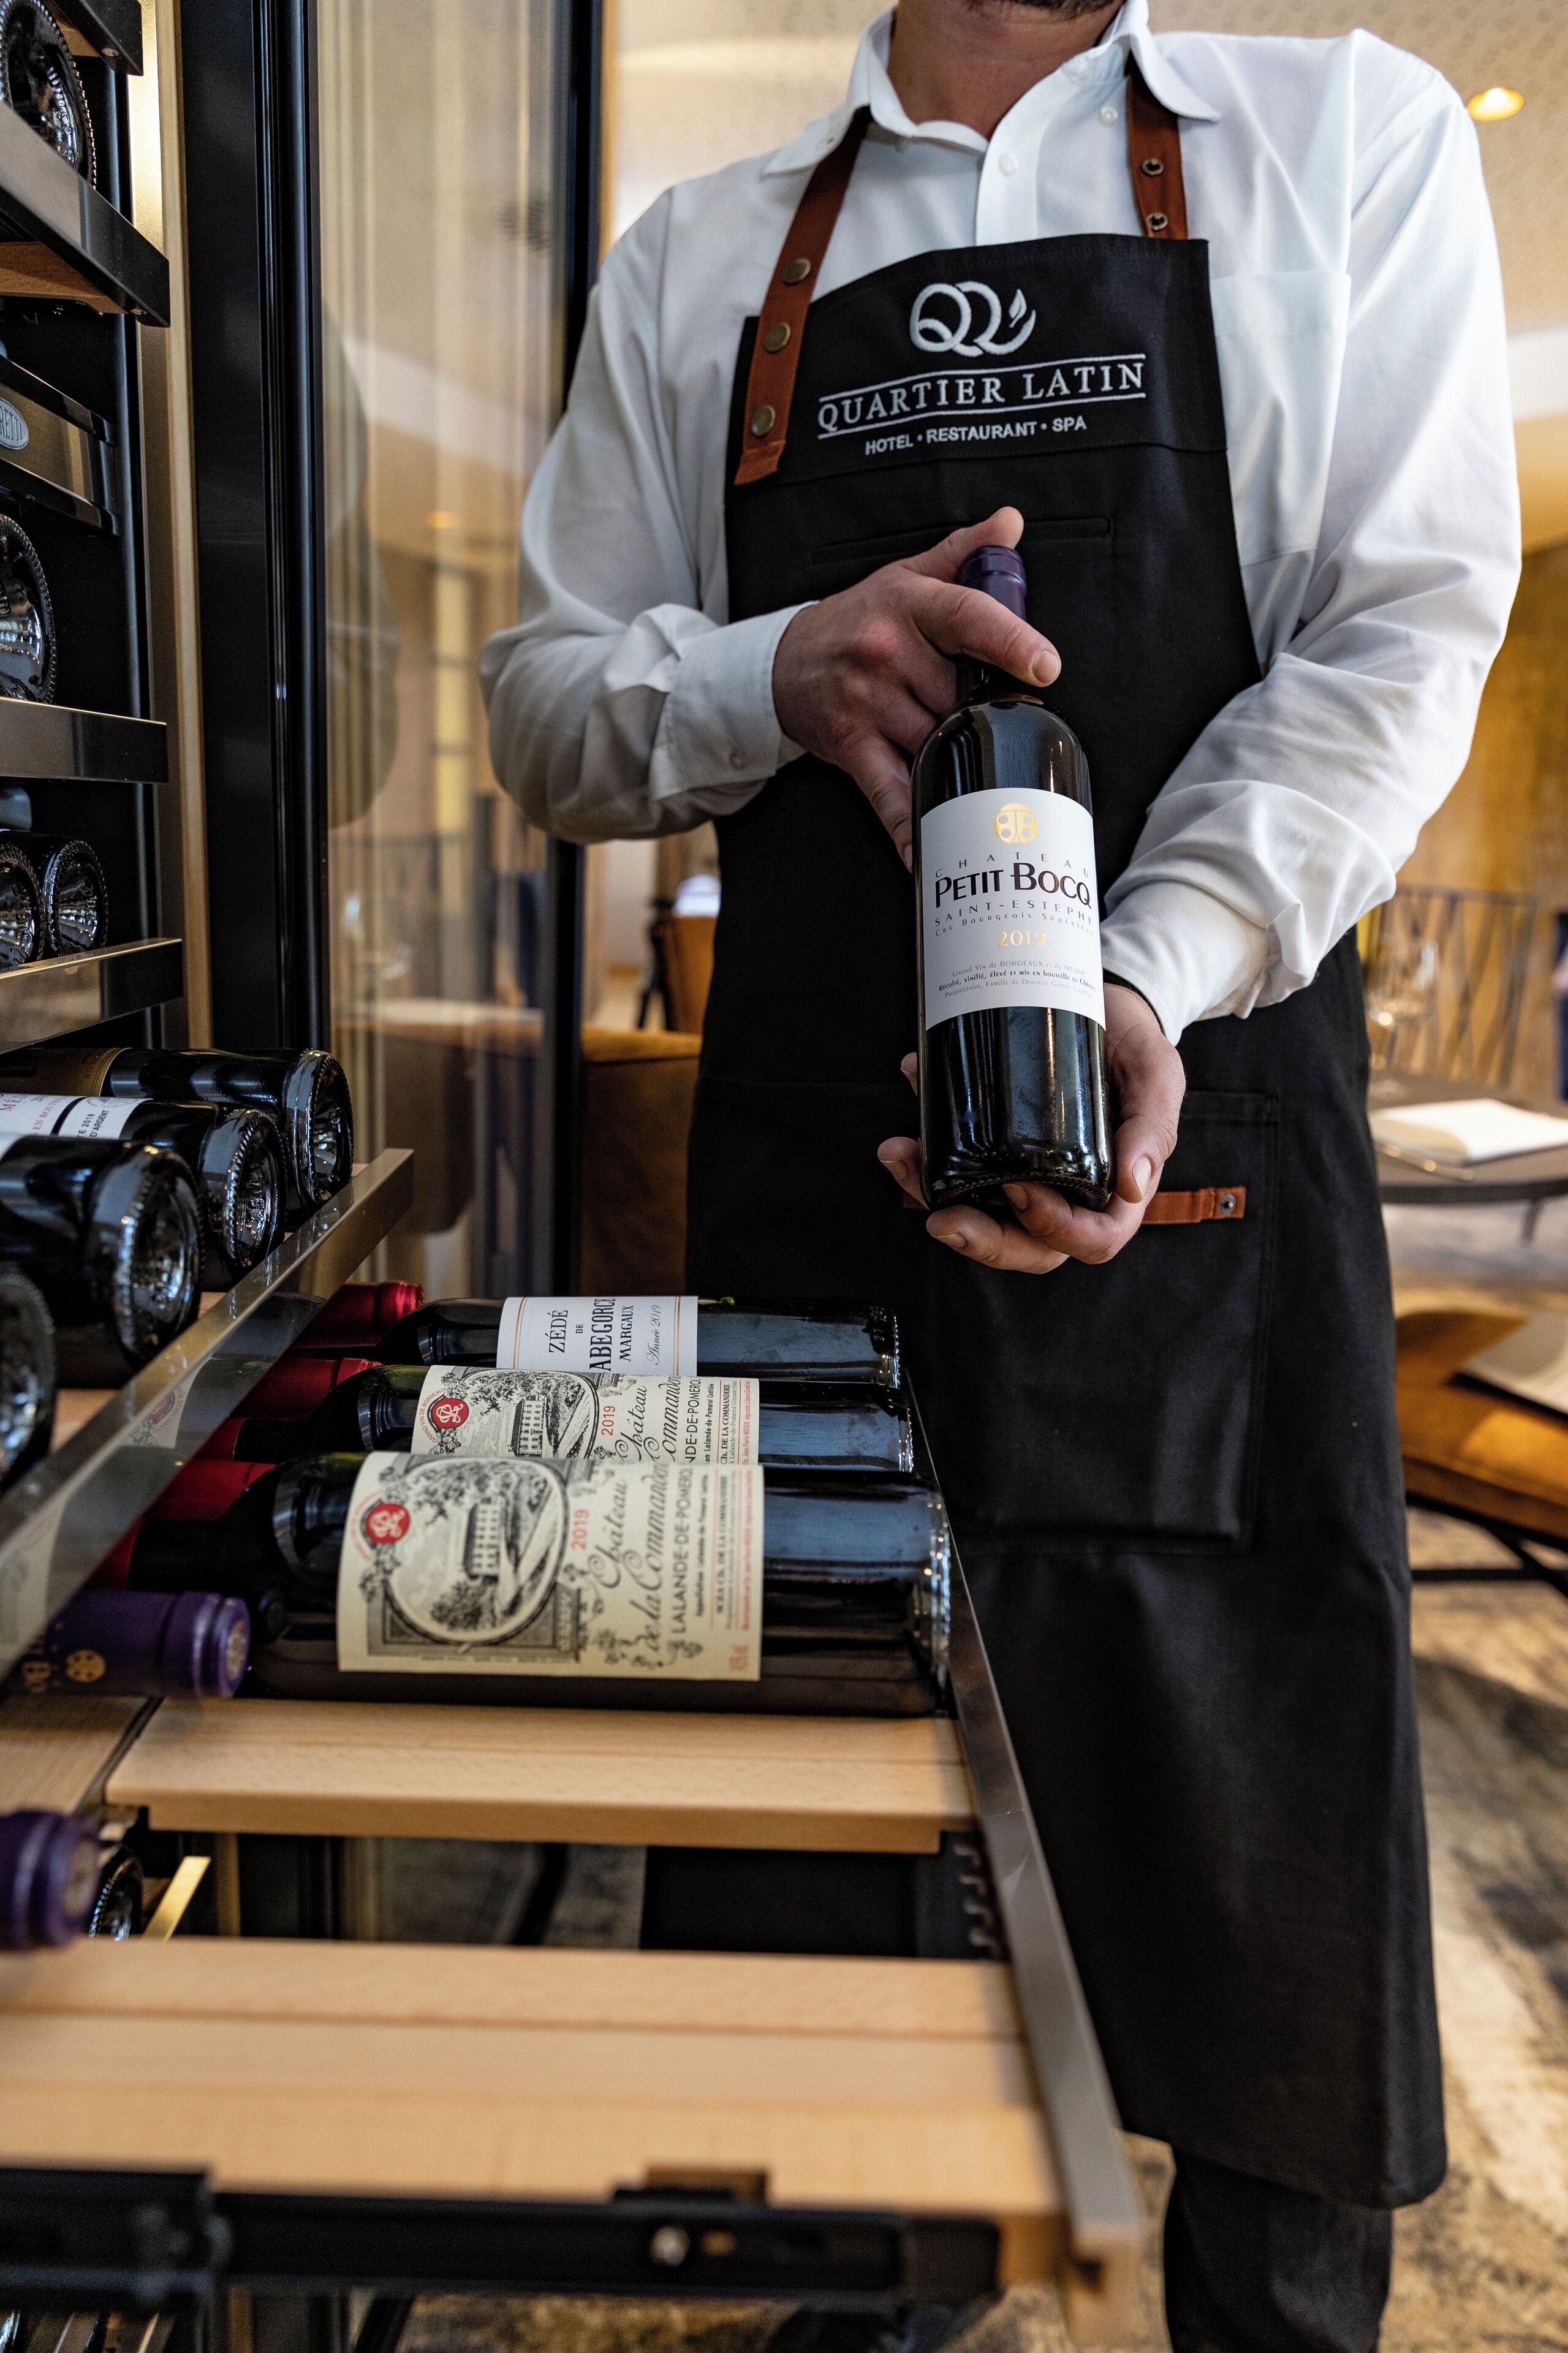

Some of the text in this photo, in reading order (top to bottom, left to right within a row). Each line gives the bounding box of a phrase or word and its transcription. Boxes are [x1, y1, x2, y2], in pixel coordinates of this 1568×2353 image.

[818, 363, 1144, 434] QUARTIER LATIN
[0, 406, 22, 441] RETTI
[865, 415, 1088, 455] HOTEL RESTAURANT SPA
[935, 852, 1089, 878] CHATEAU
[935, 862, 1092, 909] PETIT BOCQ
[935, 900, 1093, 927] SAINT-ESTEPHE
[545, 1309, 569, 1354] ZÉDÉ
[575, 1324, 584, 1334] DE
[589, 1298, 616, 1372] ABEGORCE
[619, 1305, 634, 1362] MARGAUX
[645, 1305, 662, 1366] Année 2019
[419, 1408, 425, 1416] DE
[422, 1387, 447, 1406] BORDEAUX
[422, 1425, 438, 1444] GRAND
[601, 1406, 615, 1436] 2019
[615, 1385, 647, 1462] Château
[703, 1398, 714, 1452] Lalande-de-Pomerol
[722, 1427, 729, 1436] LA
[721, 1438, 729, 1449] DE
[570, 1509, 589, 1550] 2019
